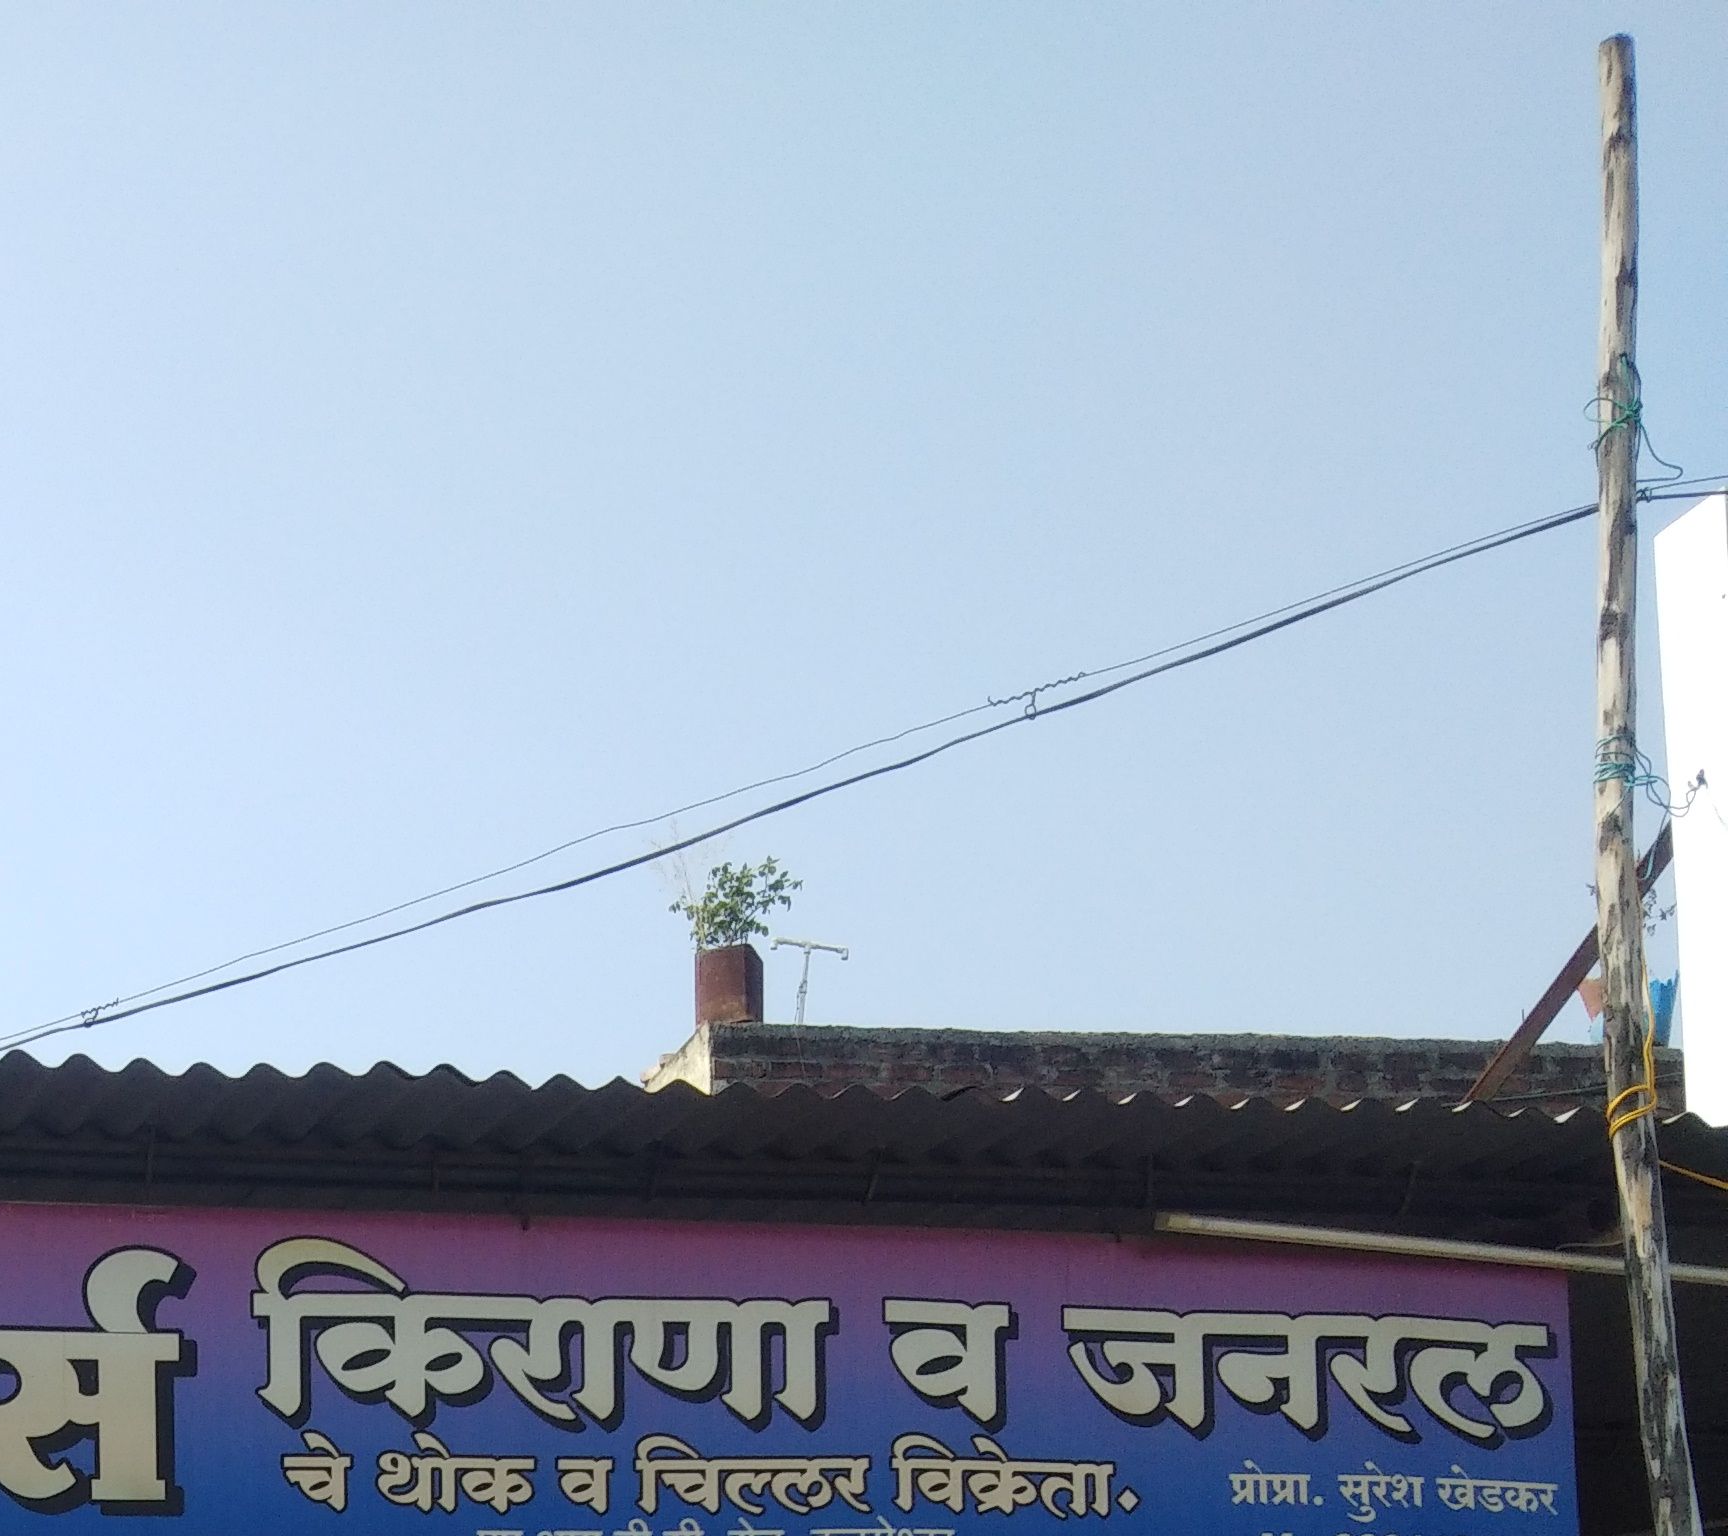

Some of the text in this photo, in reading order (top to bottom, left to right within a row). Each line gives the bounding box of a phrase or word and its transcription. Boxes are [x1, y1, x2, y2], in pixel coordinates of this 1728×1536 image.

[251, 1236, 1551, 1440] किराणा व जनरल
[283, 1432, 350, 1511] चे
[378, 1432, 535, 1511] थोक
[558, 1457, 613, 1510] व
[636, 1436, 869, 1512] चिल्लर
[1338, 1462, 1423, 1523] सुरेश
[1437, 1465, 1558, 1515] खेडकर
